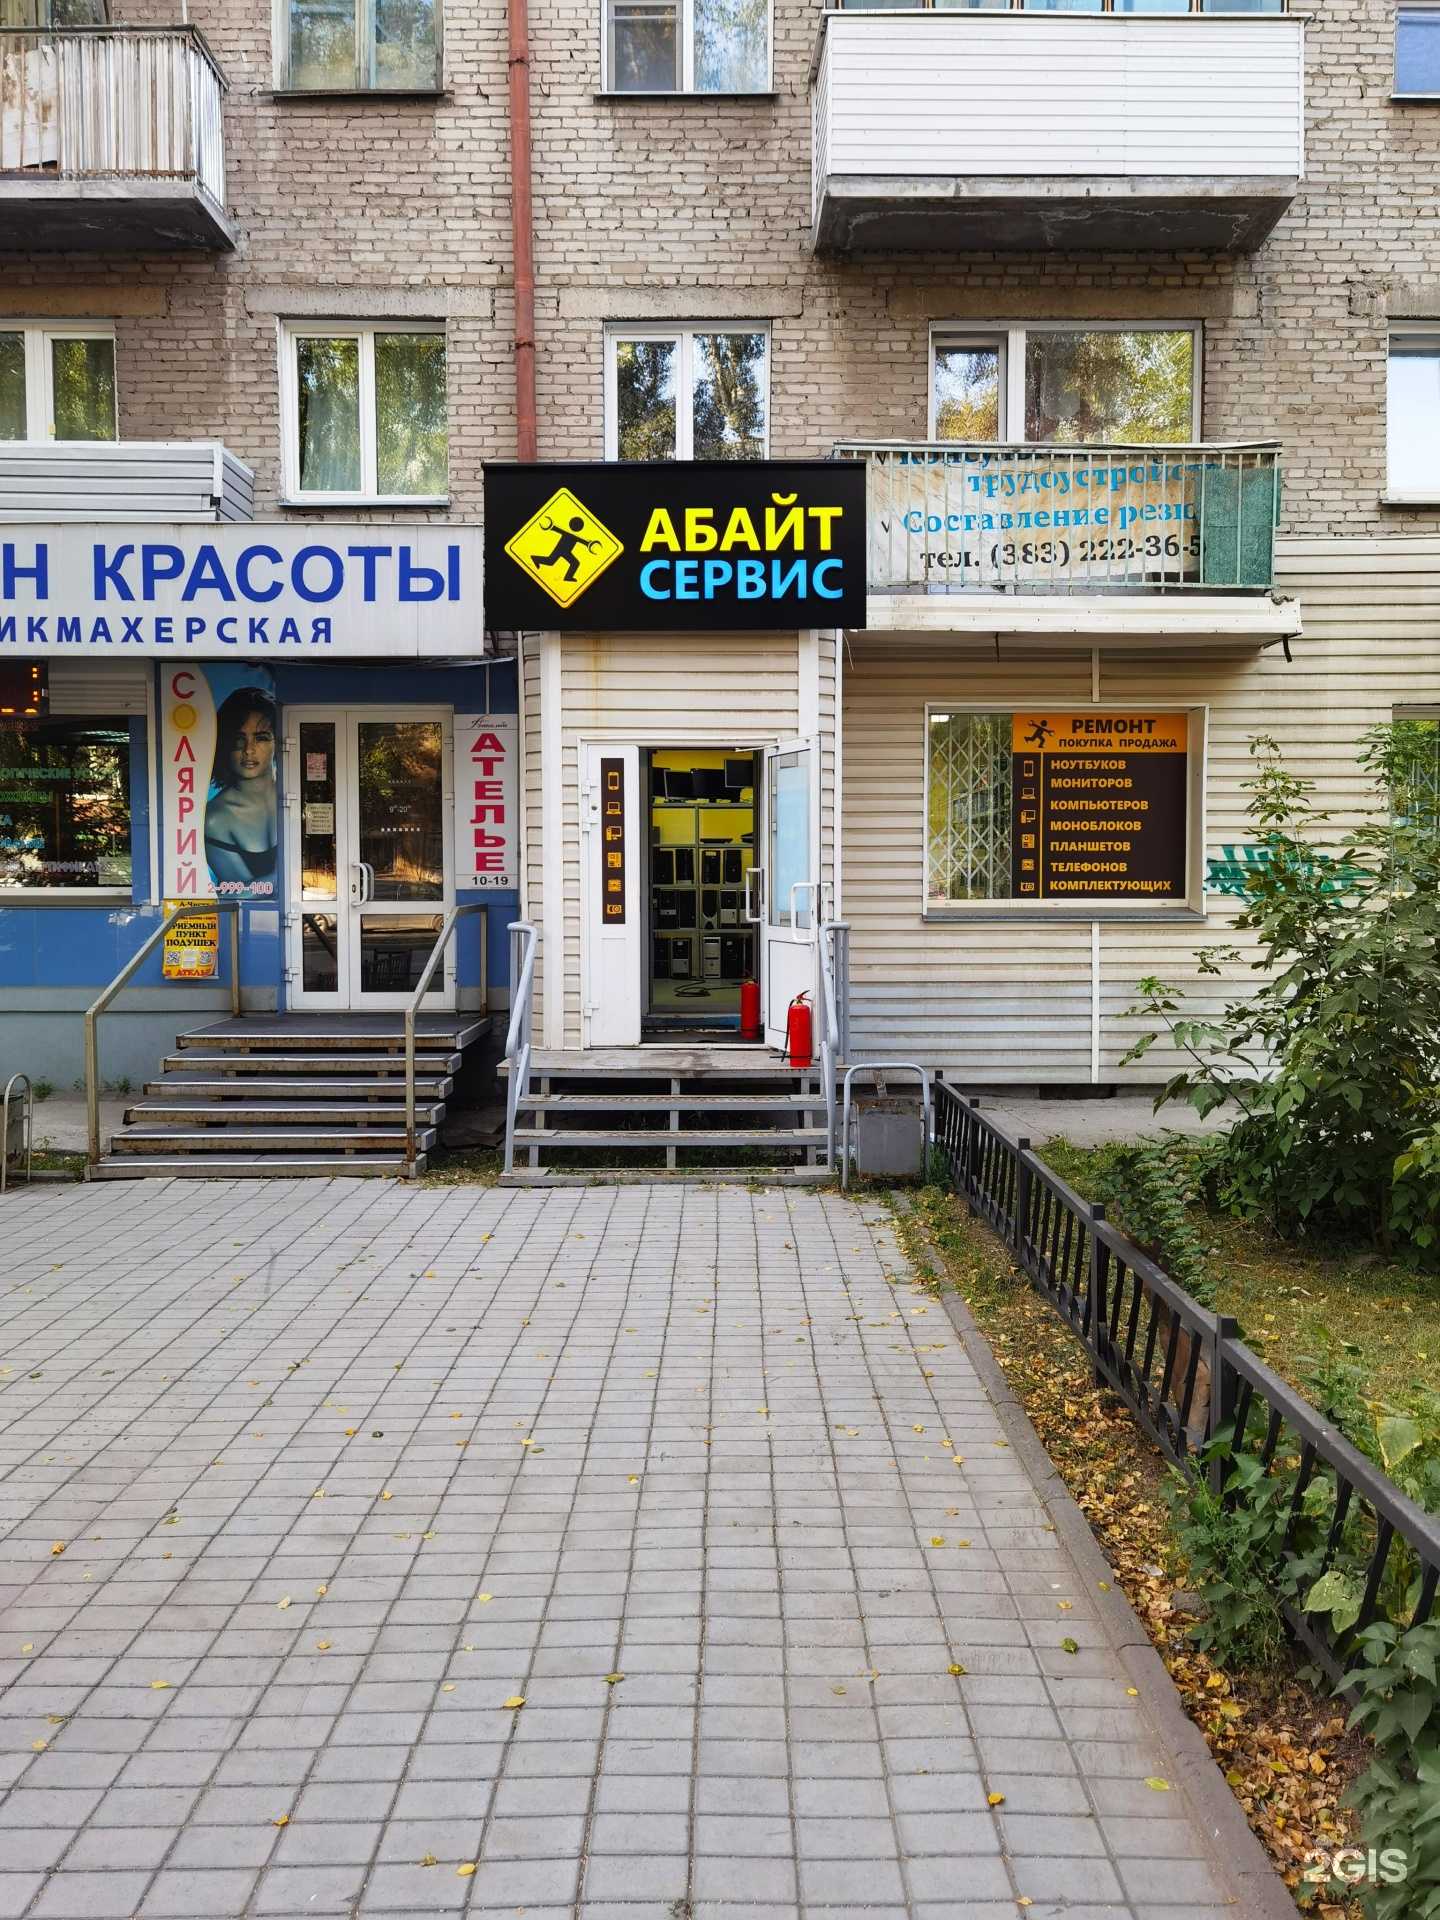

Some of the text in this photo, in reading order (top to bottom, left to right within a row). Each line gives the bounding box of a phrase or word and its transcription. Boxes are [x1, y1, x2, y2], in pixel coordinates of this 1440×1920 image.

[640, 493, 843, 552] АБАЙТ
[902, 506, 1110, 533] Составление
[920, 552, 980, 569] тел.
[991, 540, 1070, 569] (383)
[93, 544, 460, 603] КРАСОТЫ
[640, 558, 844, 600] СЕРВИС
[1072, 719, 1156, 734] РЕМОНТ
[1058, 738, 1177, 748] ПОКУПКА ПРОДАЖА
[1051, 760, 1127, 770] НОУТБУКОВ
[1051, 778, 1133, 788] МОНИТОРОВ
[470, 732, 506, 872] АТЕЛЬЕ
[1050, 800, 1149, 810] КОМПЬЮТЕРОВ
[1050, 821, 1142, 831] МОНОБЛОКОВ
[1050, 841, 1131, 851] ПЛАНШЕТОВ
[1051, 862, 1128, 872] ТЕЛЕФОНОВ
[472, 876, 509, 886] 10-19
[1050, 880, 1172, 892] КОМПЛЕКТУЮЩИХ
[166, 939, 217, 947] ПОДУШЕК
